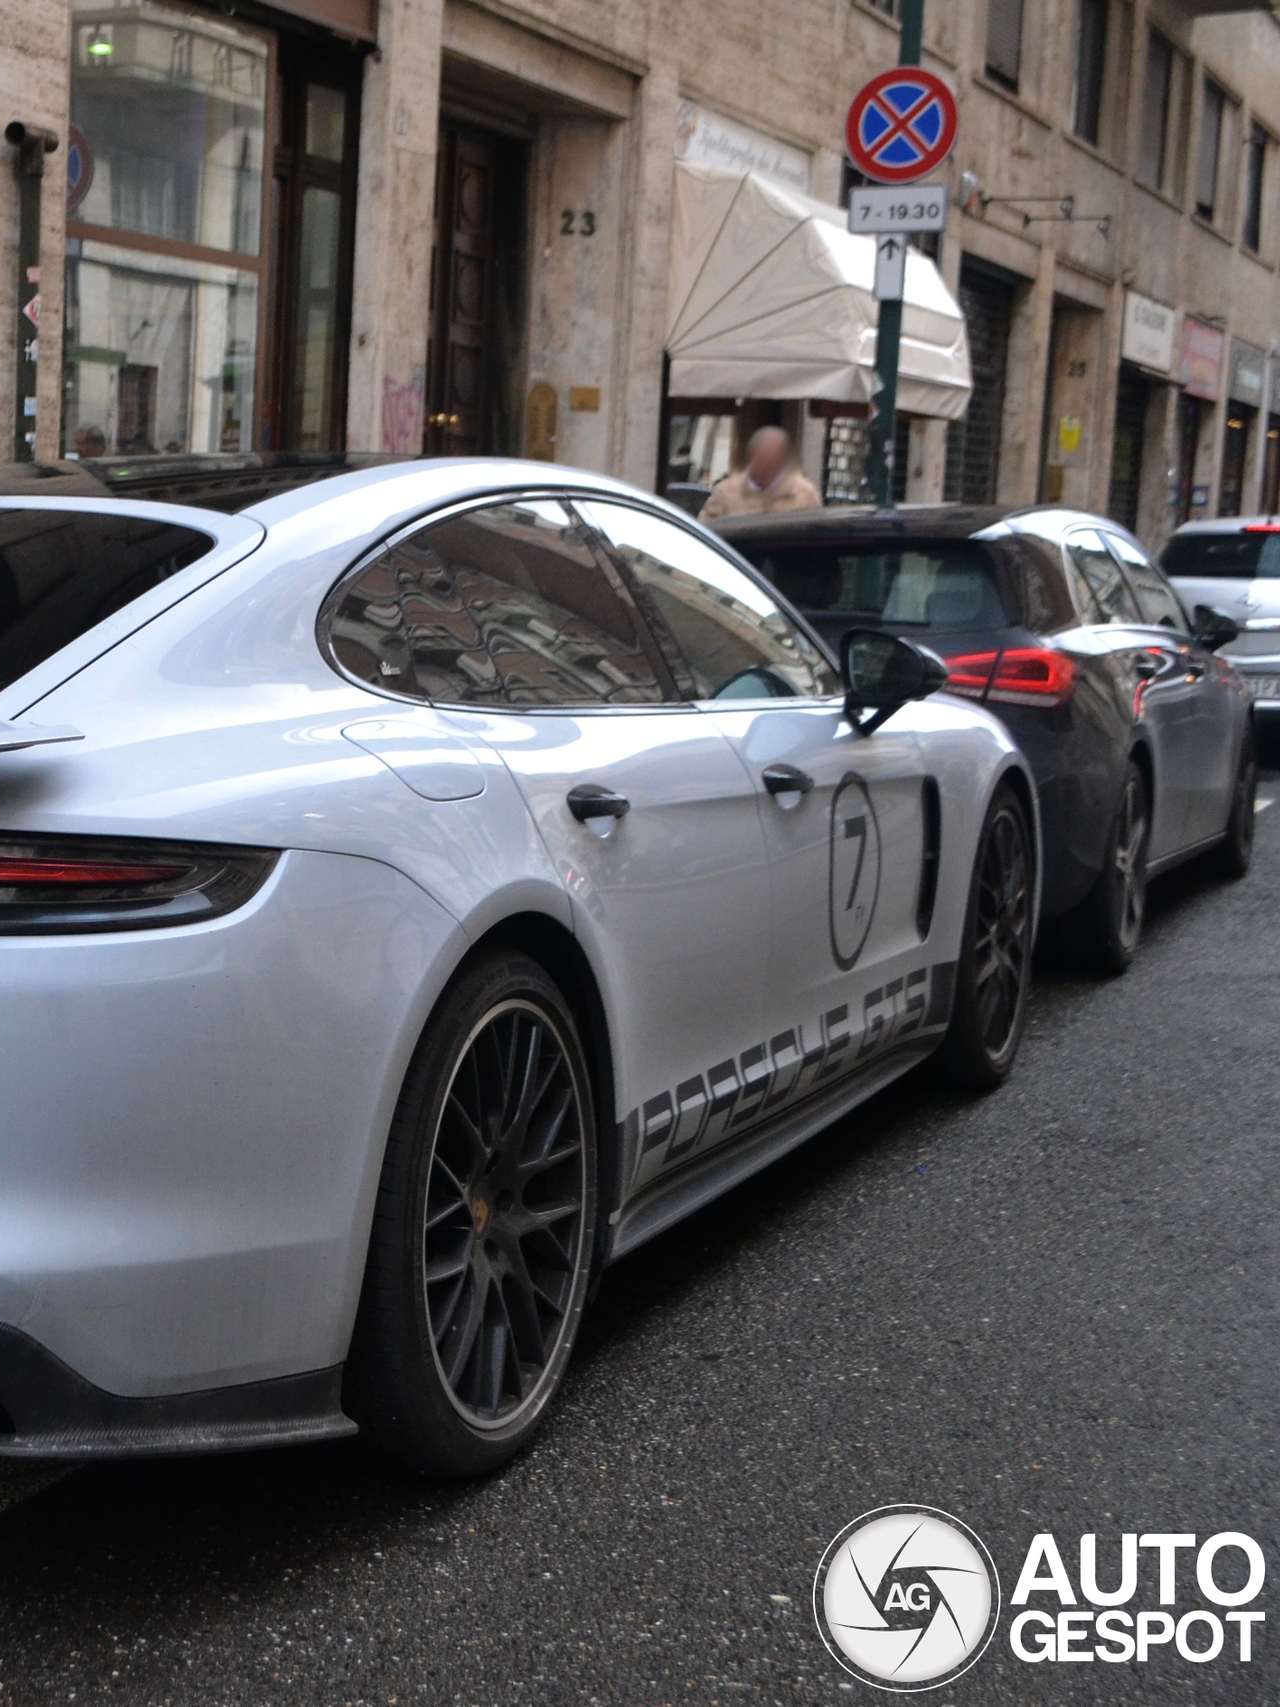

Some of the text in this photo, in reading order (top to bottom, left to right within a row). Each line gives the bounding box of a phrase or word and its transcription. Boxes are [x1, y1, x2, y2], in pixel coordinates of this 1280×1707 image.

[561, 208, 595, 237] 23
[860, 205, 871, 220] 7
[888, 203, 940, 220] 19.30
[844, 815, 867, 911] 7
